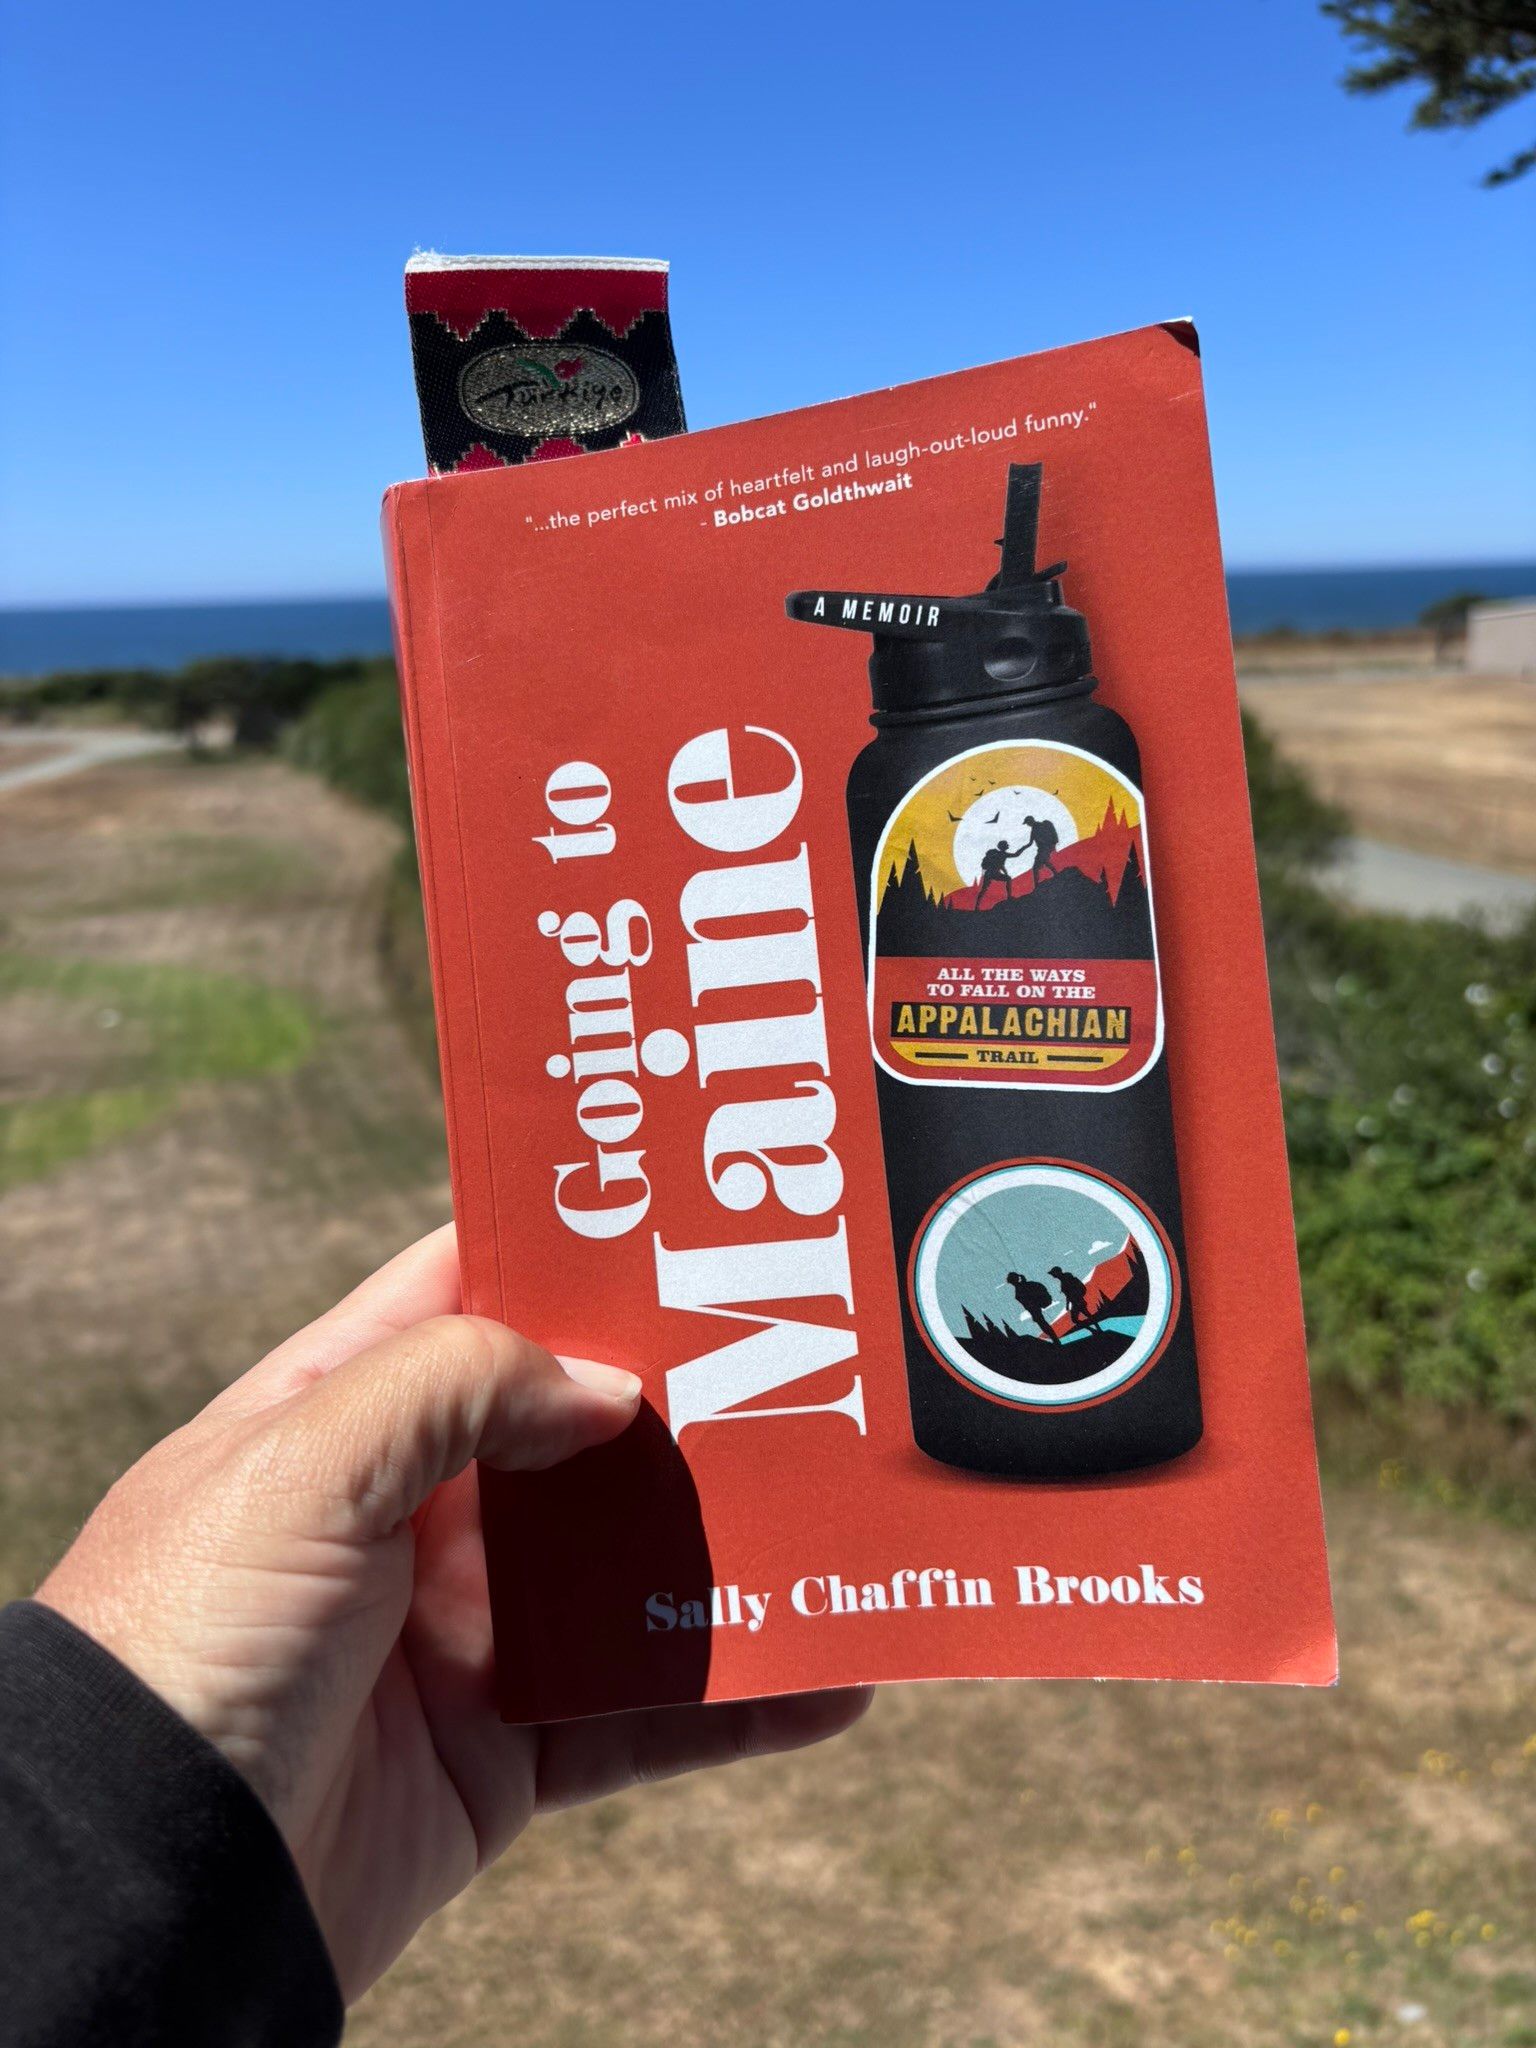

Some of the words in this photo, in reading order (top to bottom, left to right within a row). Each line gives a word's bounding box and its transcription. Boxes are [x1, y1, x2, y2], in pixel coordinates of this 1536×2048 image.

[525, 511, 581, 531] "...the
[587, 497, 658, 527] perfect
[664, 489, 698, 510] mix
[704, 481, 724, 502] of
[730, 465, 813, 495] heartfelt
[821, 453, 858, 479] and
[865, 418, 1017, 468] laugh-out-loud
[1024, 401, 1097, 433] funny."
[713, 499, 786, 528] Bobcat
[792, 473, 913, 511] Goldthwait
[813, 596, 825, 617] A
[842, 599, 940, 627] MEMOIR
[531, 760, 617, 864] to
[926, 983, 955, 997] TO
[960, 984, 1010, 999] FALL
[1015, 985, 1048, 999] ON
[1052, 986, 1096, 1000] THE
[936, 967, 975, 981] ALL
[981, 968, 1024, 982] THE
[1029, 968, 1086, 983] WAYS
[896, 1004, 1129, 1040] APPALACHIAN
[537, 898, 653, 1240] Going
[640, 724, 868, 1446] Maine
[976, 1050, 1039, 1065] TRAIL
[646, 1584, 772, 1632] Sally
[790, 1567, 995, 1617] Chaffin
[1013, 1564, 1205, 1606] Brooks
